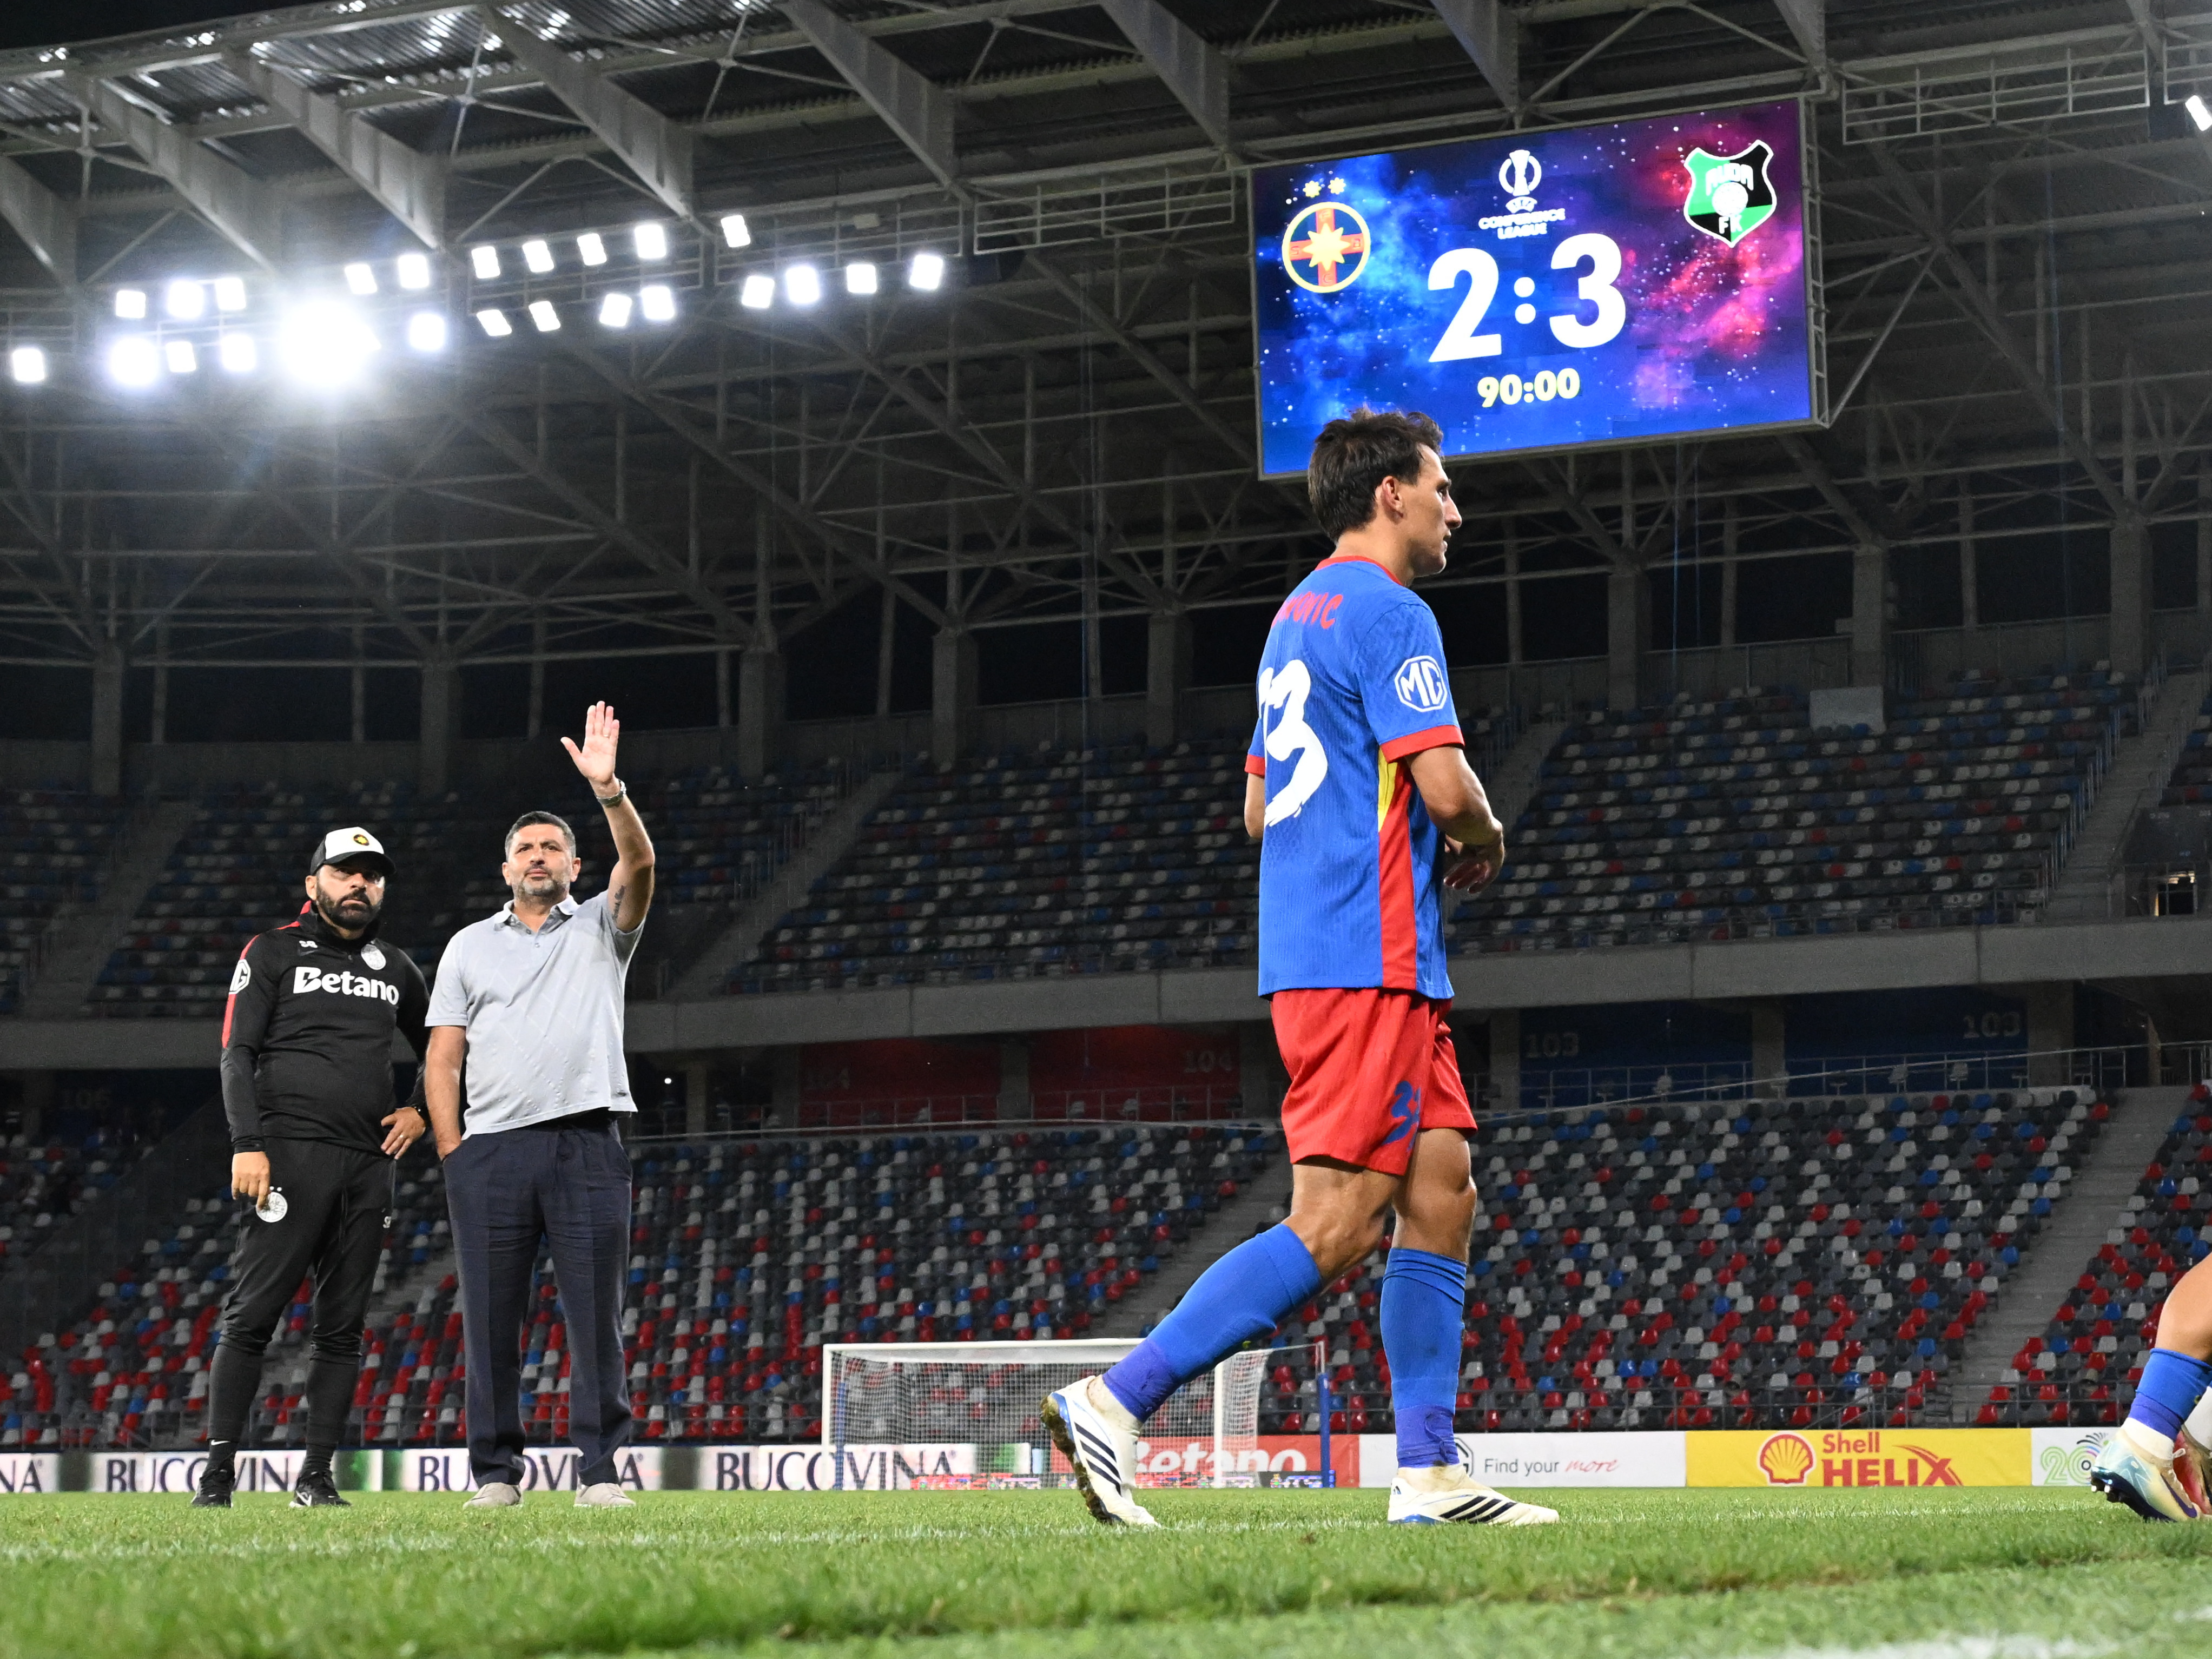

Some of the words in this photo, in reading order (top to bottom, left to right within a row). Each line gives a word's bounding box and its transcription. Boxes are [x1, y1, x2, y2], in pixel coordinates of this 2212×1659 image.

[1719, 214, 1742, 234] FK
[1477, 368, 1580, 407] 90:00
[293, 967, 399, 1005] Betano
[1963, 1012, 2020, 1039] 103
[1526, 1032, 1579, 1058] 103
[1822, 1431, 1880, 1454] Shell
[1484, 1458, 1518, 1473] Find
[1524, 1461, 1560, 1477] your
[1564, 1459, 1619, 1473] more
[1821, 1445, 1963, 1487] HELIX
